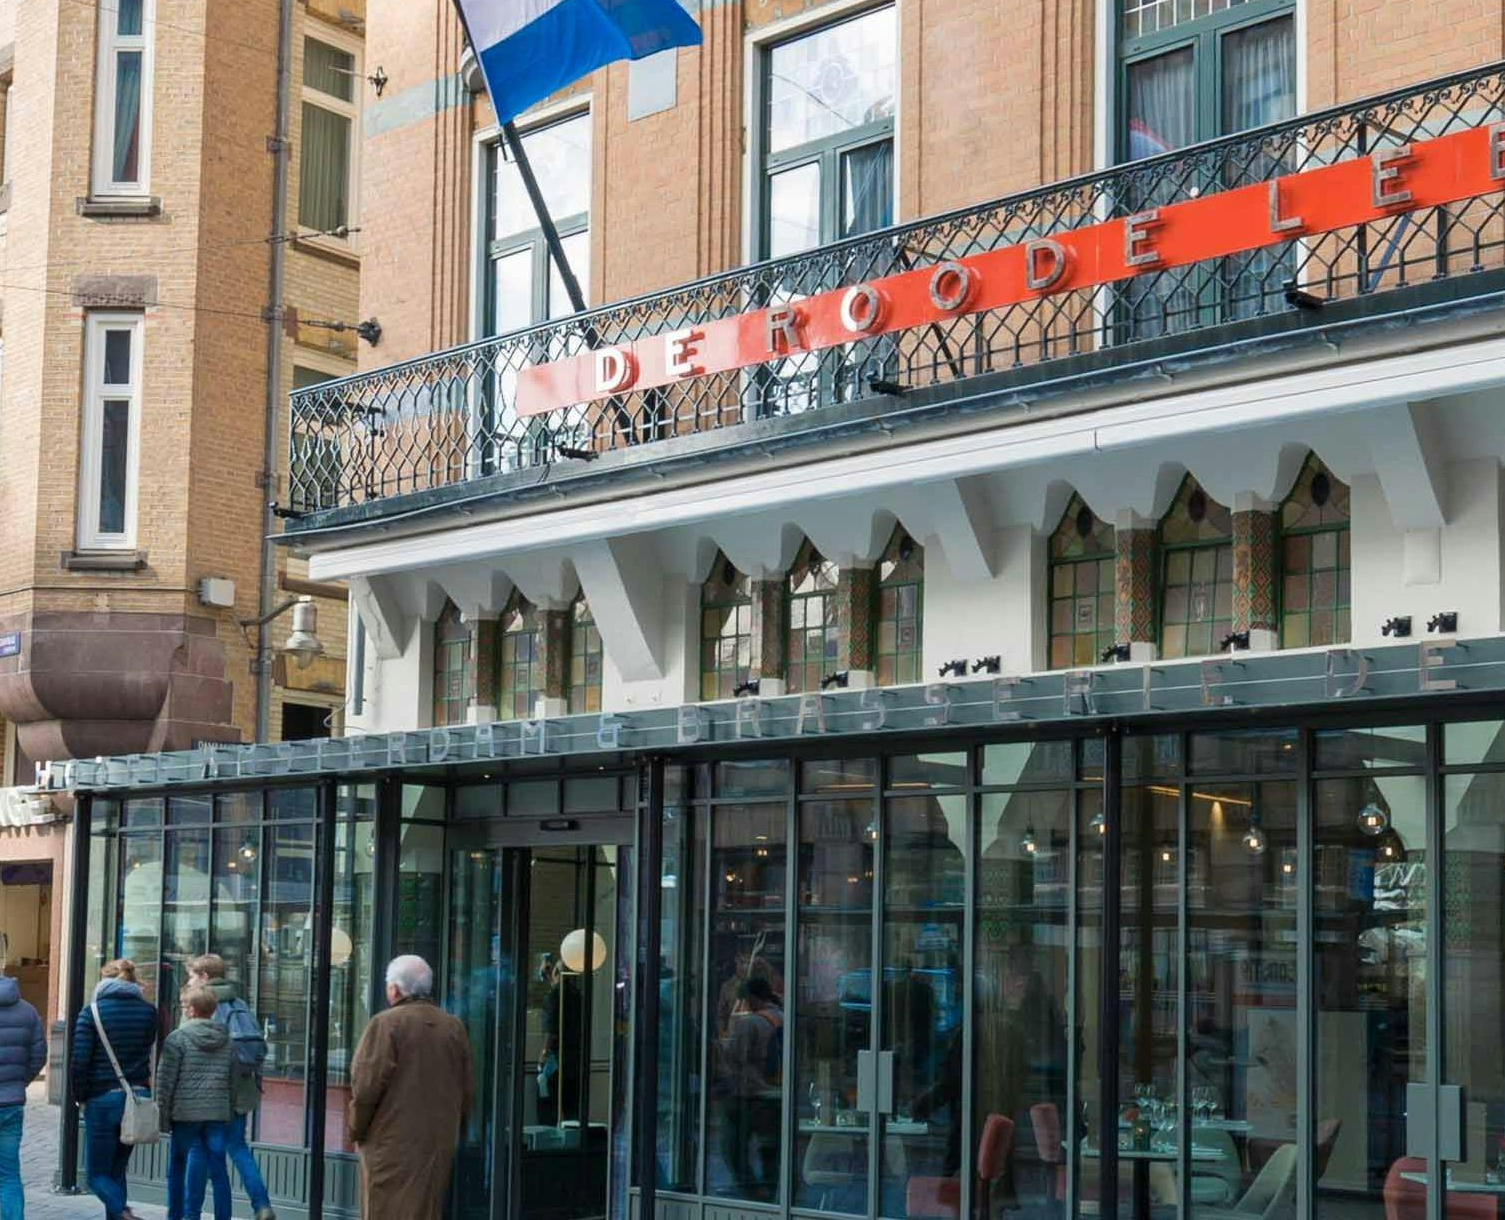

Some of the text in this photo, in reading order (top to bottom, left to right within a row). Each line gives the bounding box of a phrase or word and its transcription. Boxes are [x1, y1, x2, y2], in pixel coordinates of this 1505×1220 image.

[595, 328, 704, 393] DE
[766, 211, 1161, 354] ROODE
[678, 660, 1234, 743] BRASSERIE
[1326, 638, 1457, 698] DE
